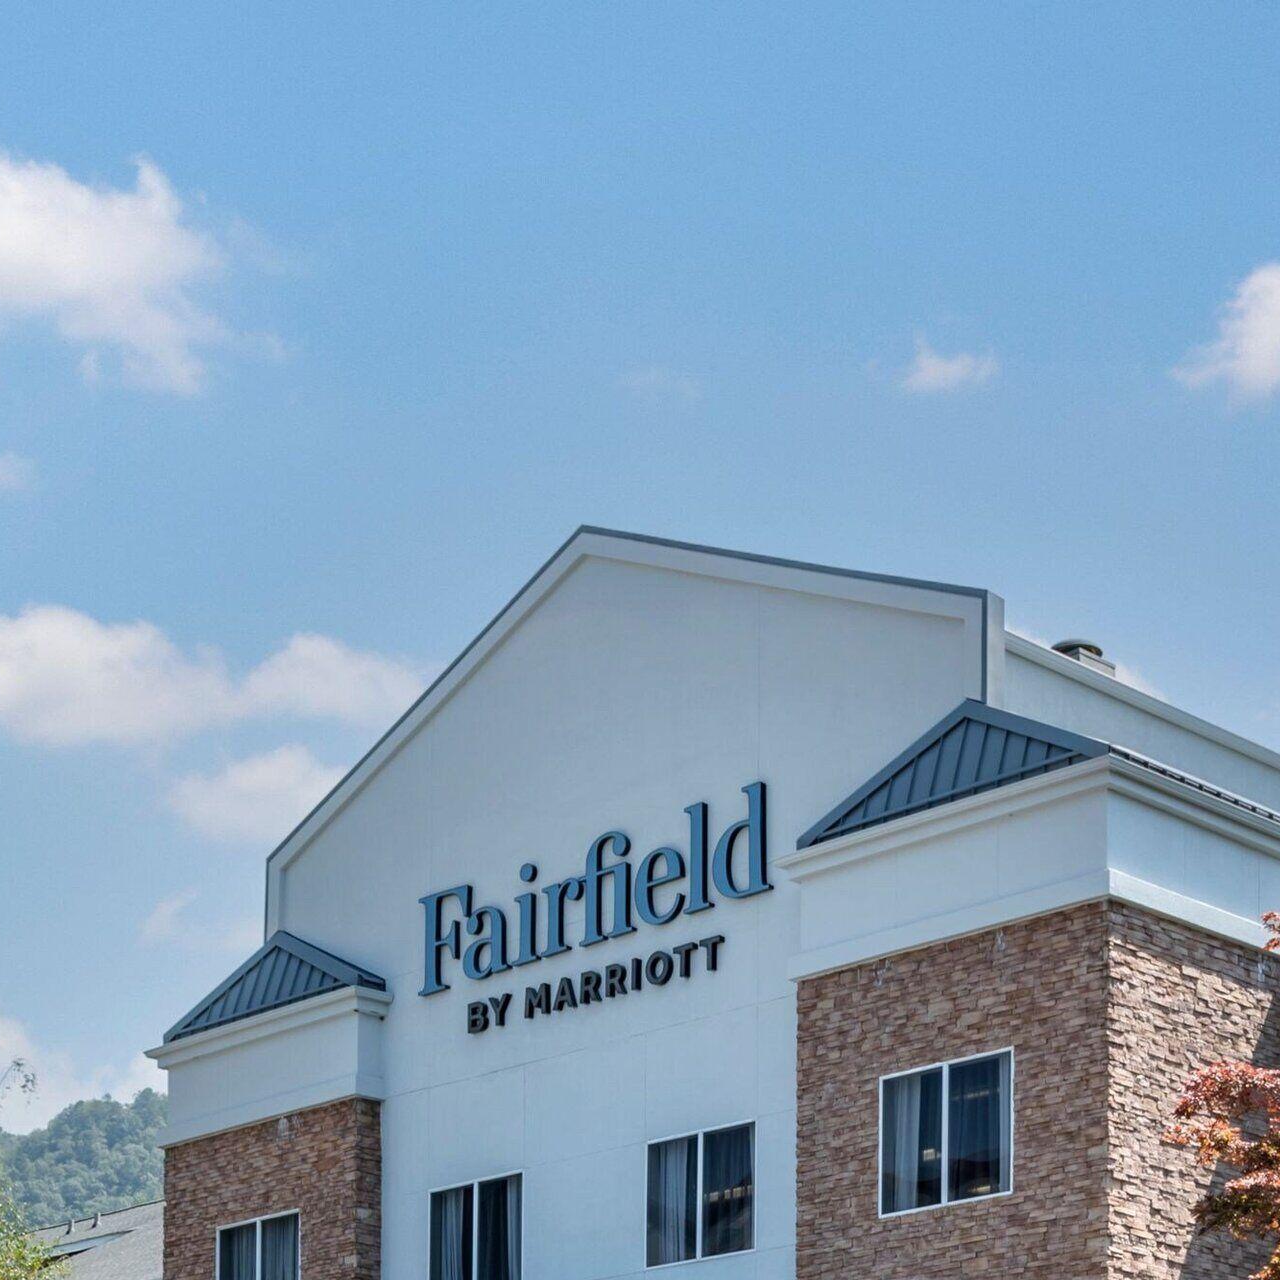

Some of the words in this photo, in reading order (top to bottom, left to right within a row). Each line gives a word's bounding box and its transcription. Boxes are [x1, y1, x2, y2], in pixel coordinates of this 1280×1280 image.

[418, 781, 774, 996] Fairfield
[467, 993, 512, 1033] BY
[524, 934, 725, 1019] MARRIOTT
